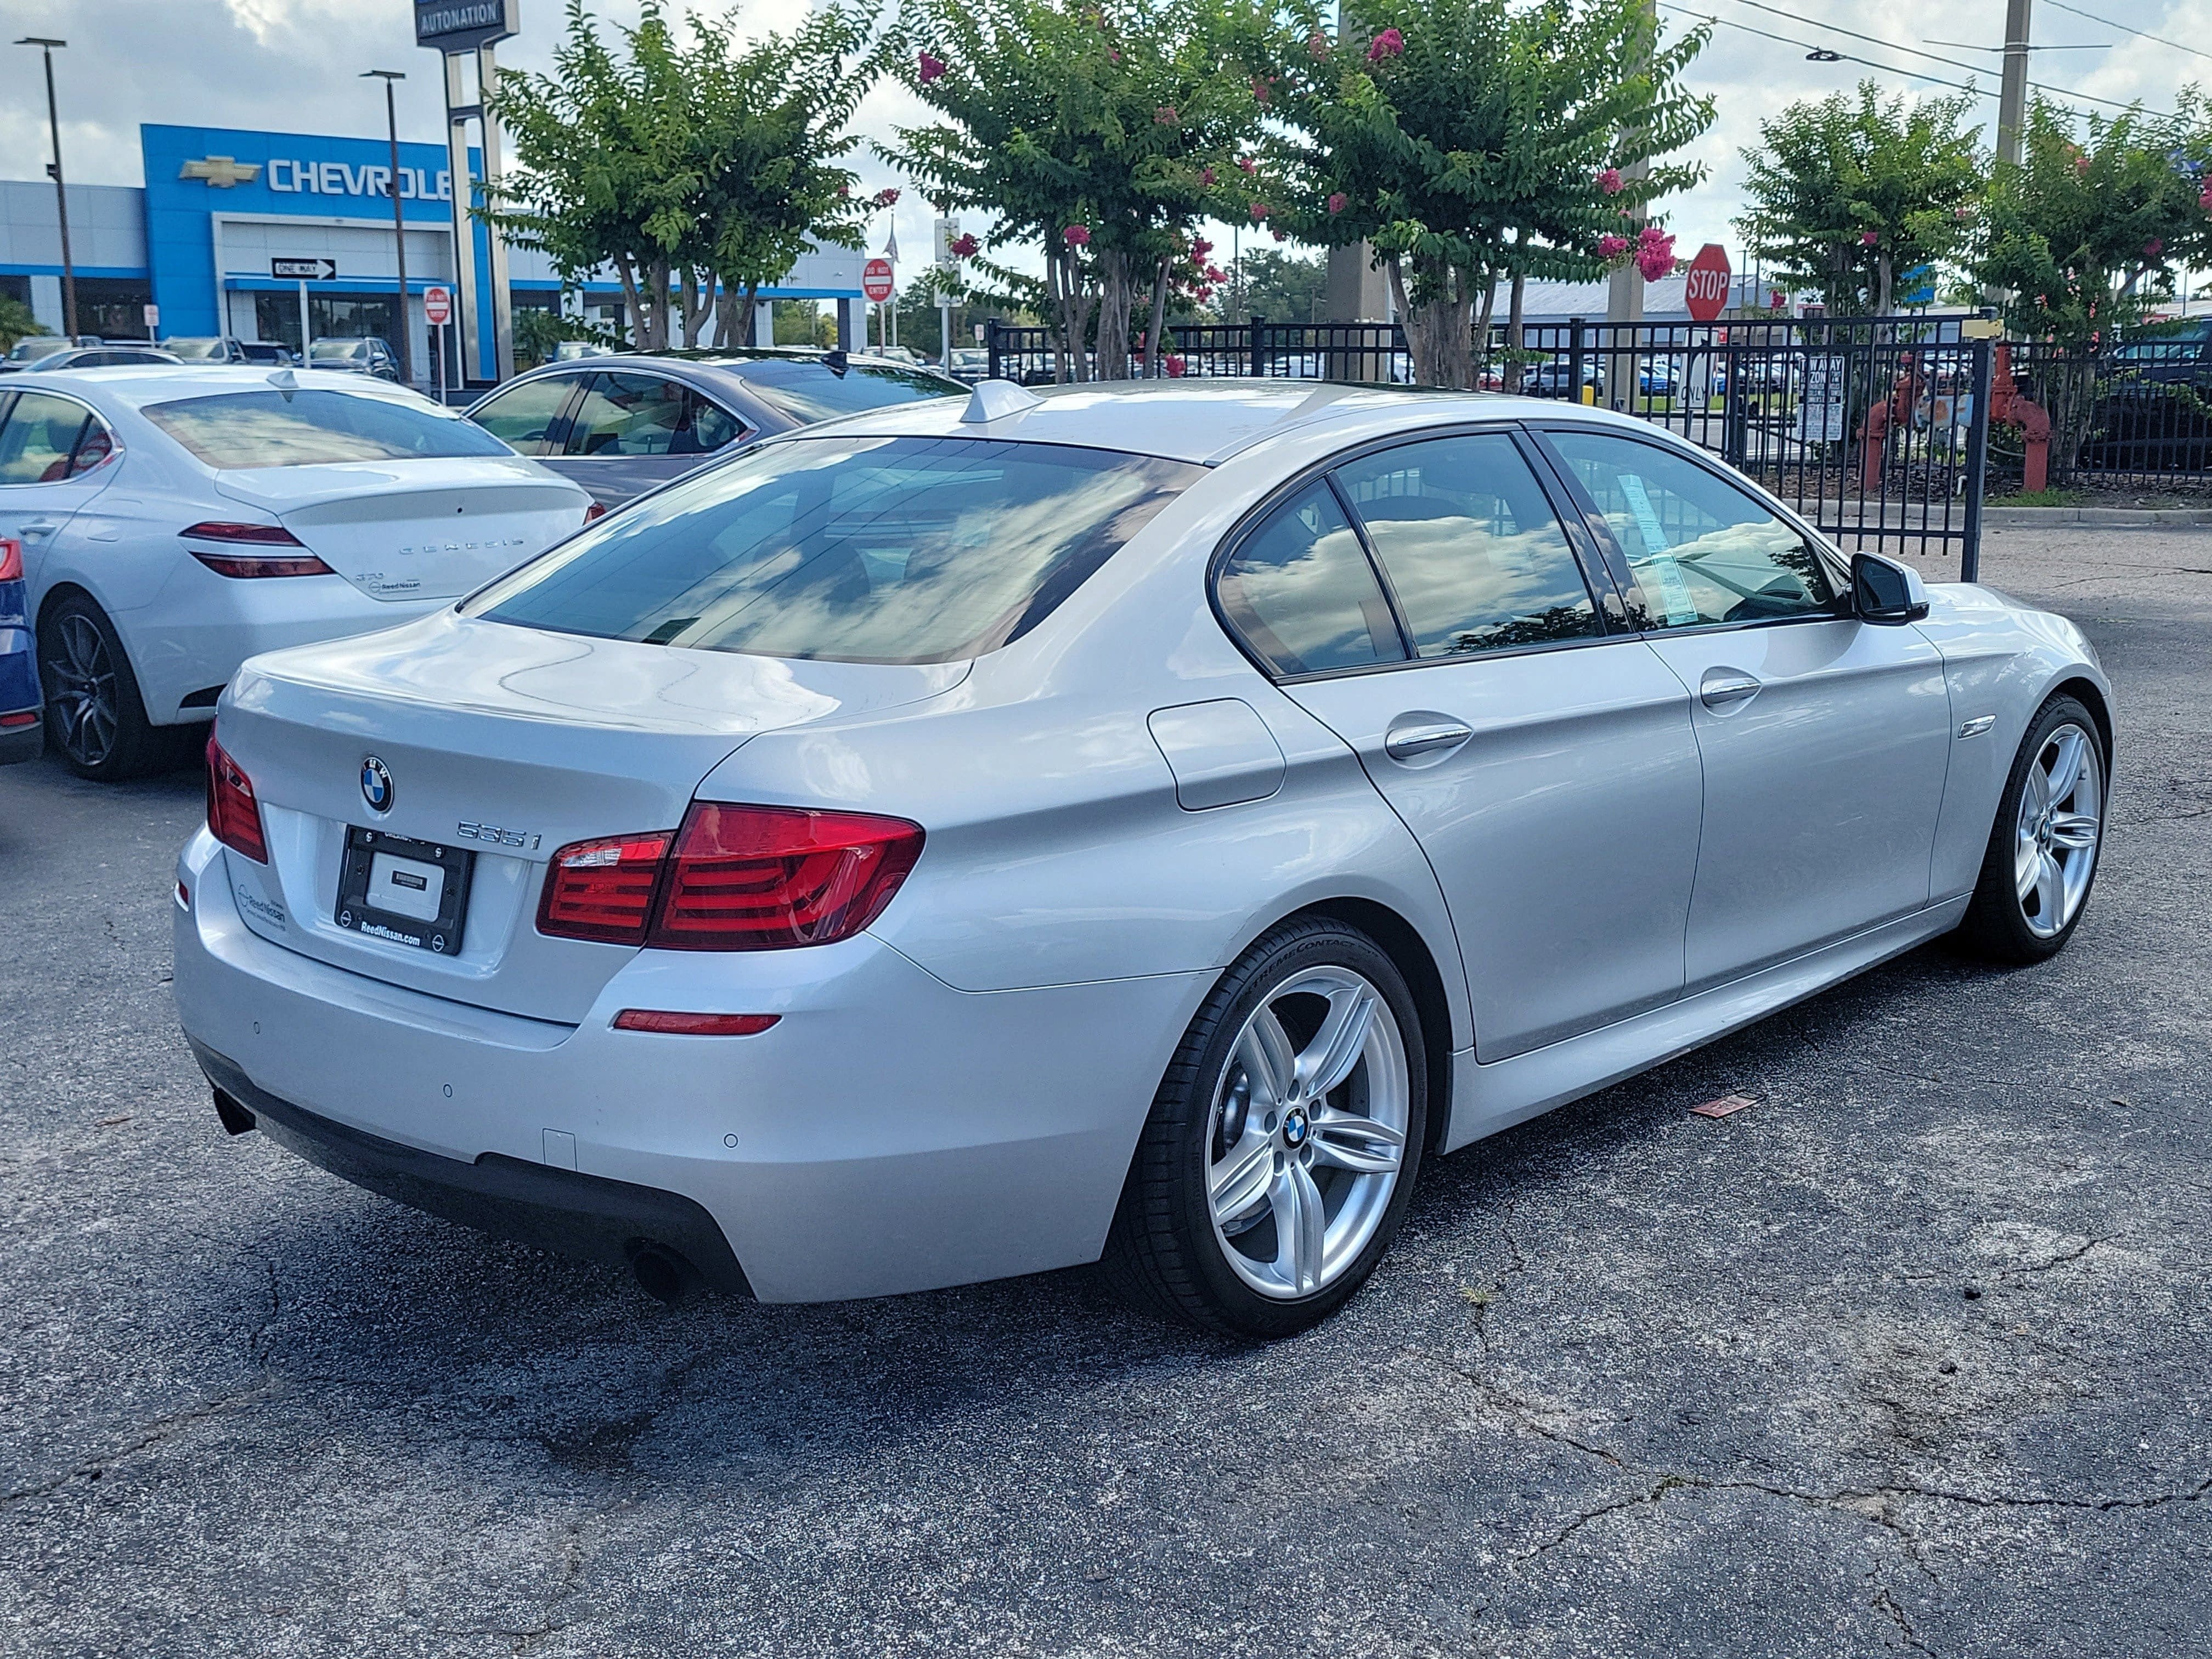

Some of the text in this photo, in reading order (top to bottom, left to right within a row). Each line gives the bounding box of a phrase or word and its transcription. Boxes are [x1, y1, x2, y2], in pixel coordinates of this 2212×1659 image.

[421, 3, 498, 34] AUTONATION
[1688, 269, 1728, 301] STOP
[1801, 359, 1818, 371] TW
[1810, 371, 1826, 383] ZON
[399, 538, 523, 554] GENESIS
[361, 921, 420, 946] ReedNissan.com
